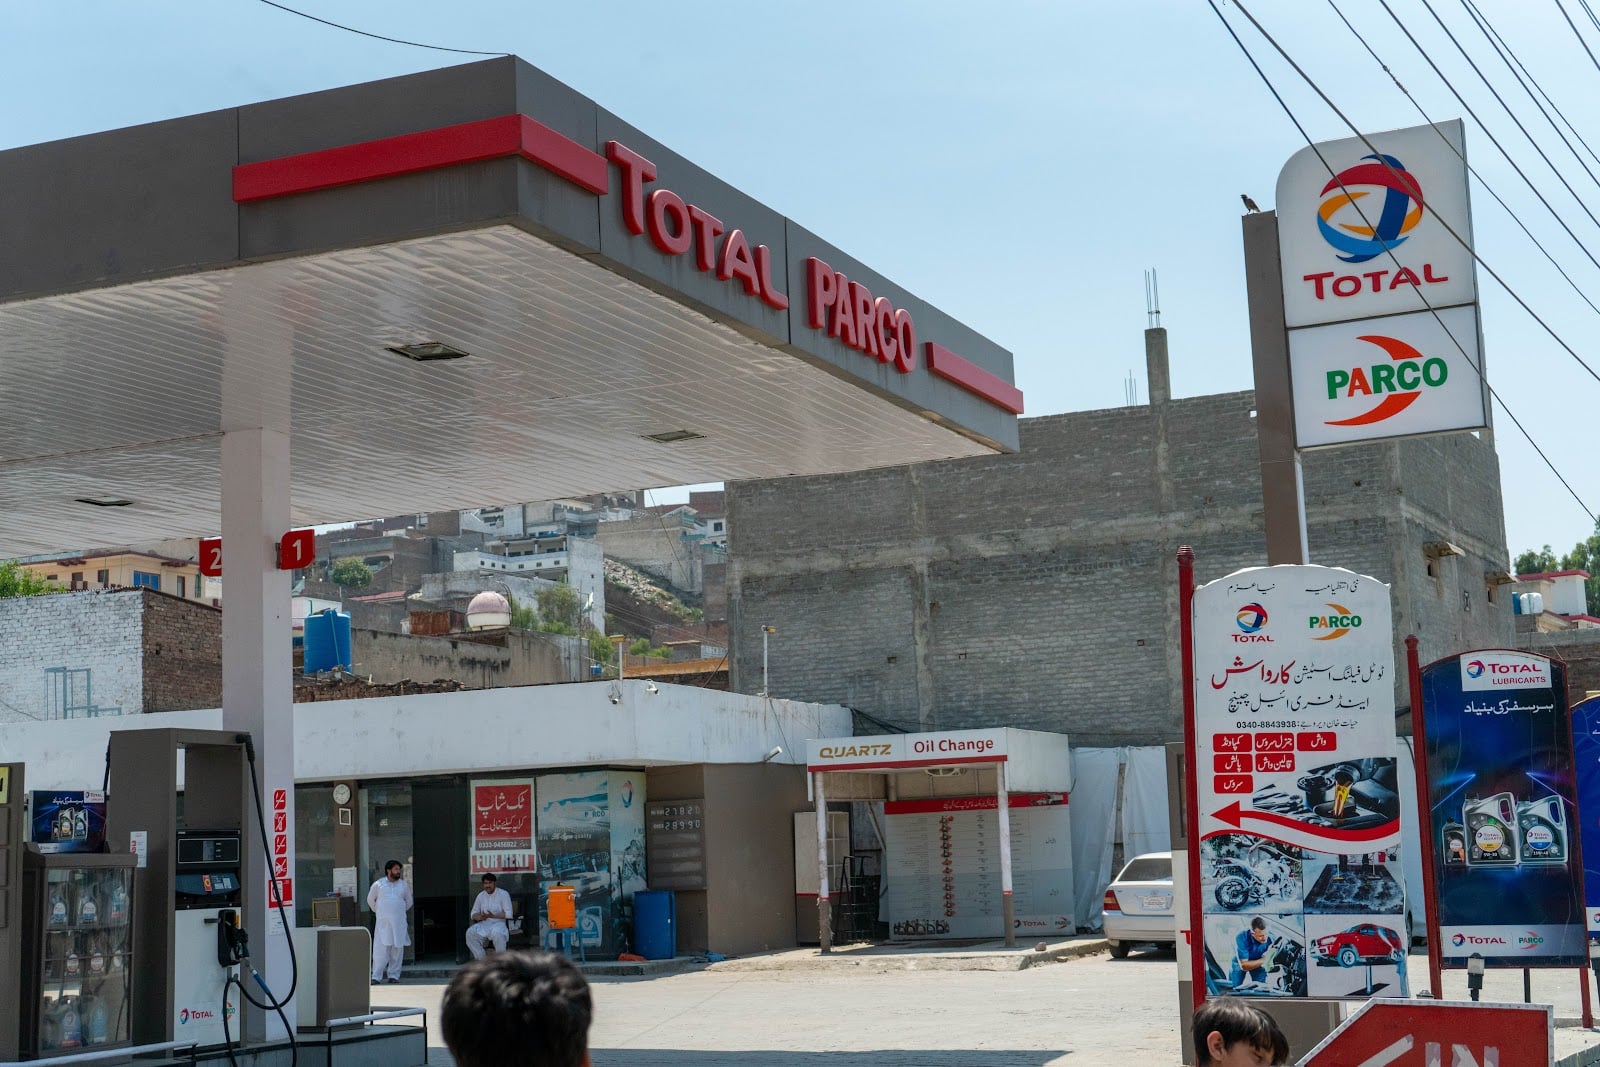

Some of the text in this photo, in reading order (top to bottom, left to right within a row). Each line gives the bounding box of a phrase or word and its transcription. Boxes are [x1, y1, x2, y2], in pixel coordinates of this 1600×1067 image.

[605, 140, 916, 374] TOTAL PARCO
[1303, 263, 1449, 300] TOTAL
[1326, 357, 1448, 400] PARCO
[292, 539, 301, 561] 1
[209, 547, 222, 570] 2
[1227, 582, 1275, 599] نیا عزم
[1309, 616, 1362, 629] PARCO
[1232, 634, 1274, 643] TOTAL
[1294, 662, 1335, 684] اسٹیشن
[1488, 663, 1542, 674] TOTAL
[1492, 676, 1546, 685] LUBRICANTS
[1291, 694, 1334, 711] فری
[1335, 693, 1369, 710] اینڈ
[1464, 700, 1493, 716] بنیاد
[1236, 720, 1296, 729] 0340-8843938
[914, 739, 994, 753] Oil Change
[1310, 733, 1326, 747] واش
[819, 743, 892, 759] QUARTZ
[1223, 780, 1243, 792] سروس
[477, 792, 506, 819] شاپ
[1467, 936, 1507, 944] TOTAL
[191, 1010, 214, 1019] TOTAL
